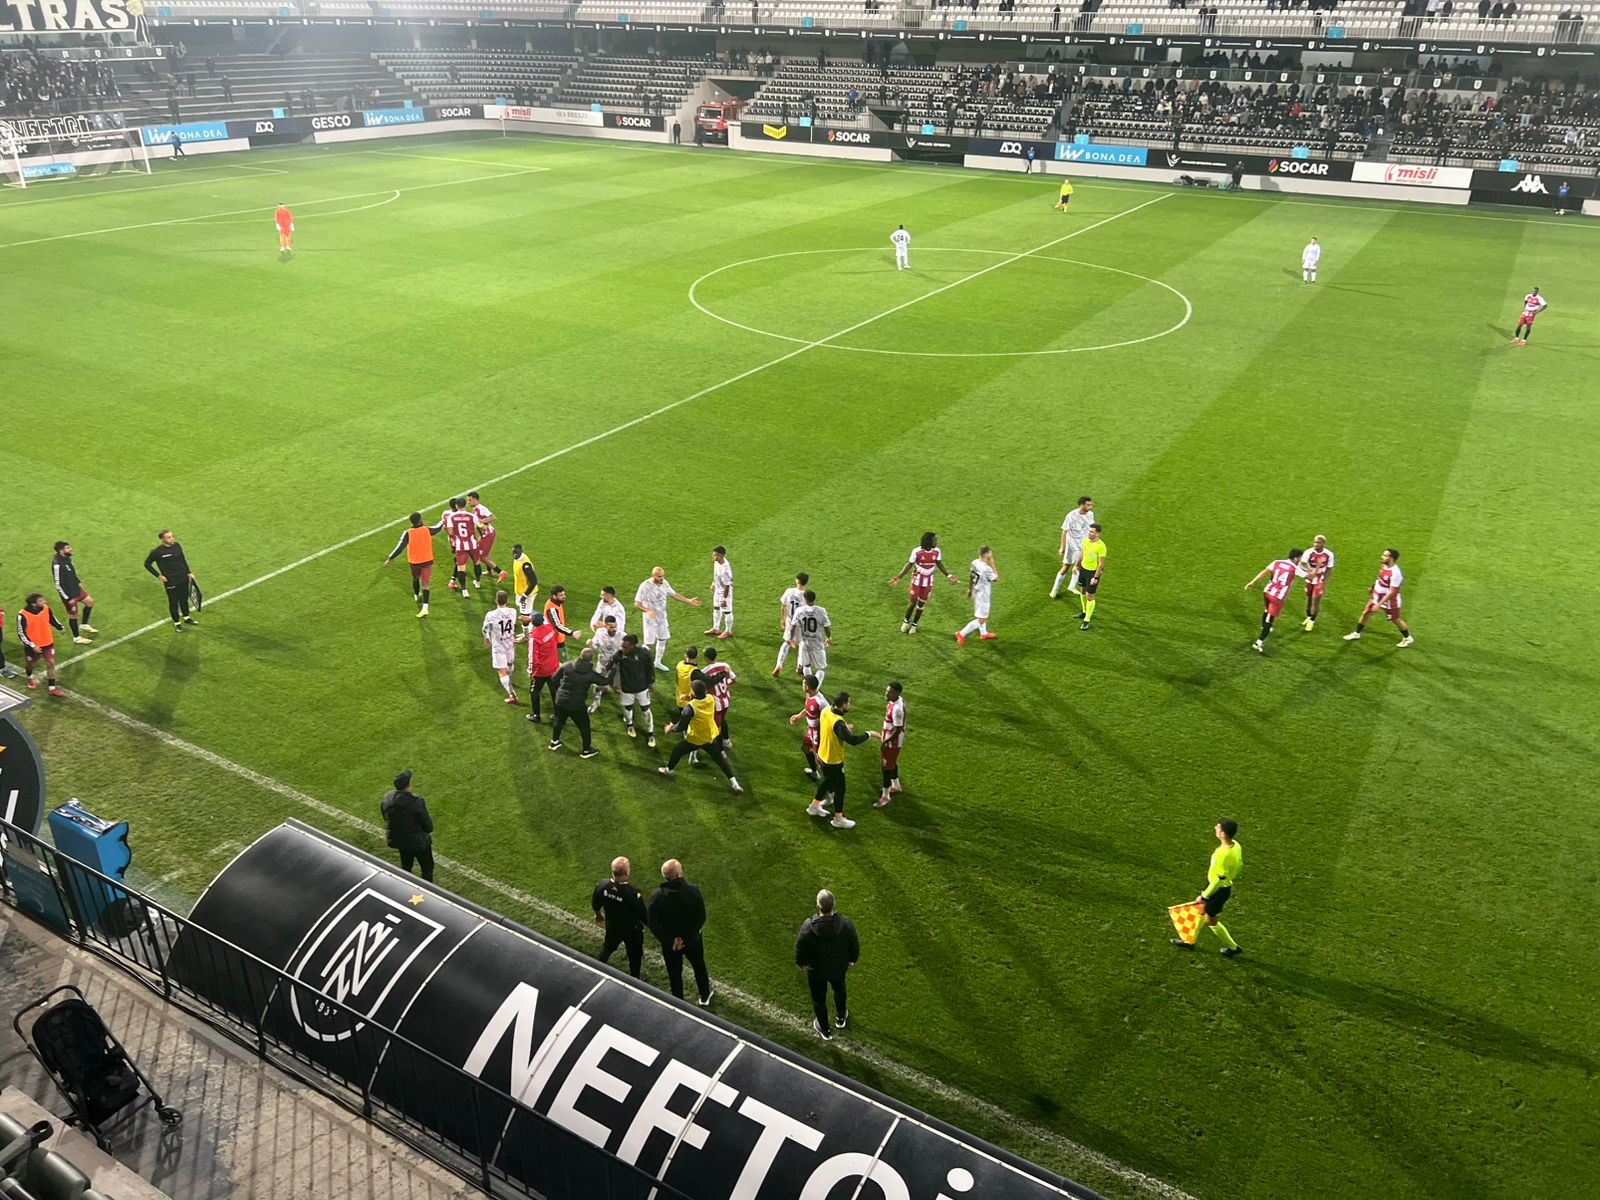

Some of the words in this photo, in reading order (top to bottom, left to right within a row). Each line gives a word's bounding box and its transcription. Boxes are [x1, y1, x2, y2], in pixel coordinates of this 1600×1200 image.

[441, 107, 471, 117] SOCAR
[511, 107, 532, 116] misli
[312, 115, 351, 129] GESCO
[622, 116, 651, 127] SOCAR
[203, 129, 223, 138] DEA
[835, 131, 870, 144] SOCAR
[1085, 151, 1115, 162] BONA
[1118, 153, 1141, 163] DEA
[1279, 160, 1329, 175] SOCAR
[1397, 166, 1438, 179] misli
[457, 522, 468, 537] 6
[1272, 568, 1290, 587] 14
[498, 619, 512, 636] 14
[802, 616, 818, 634] 10
